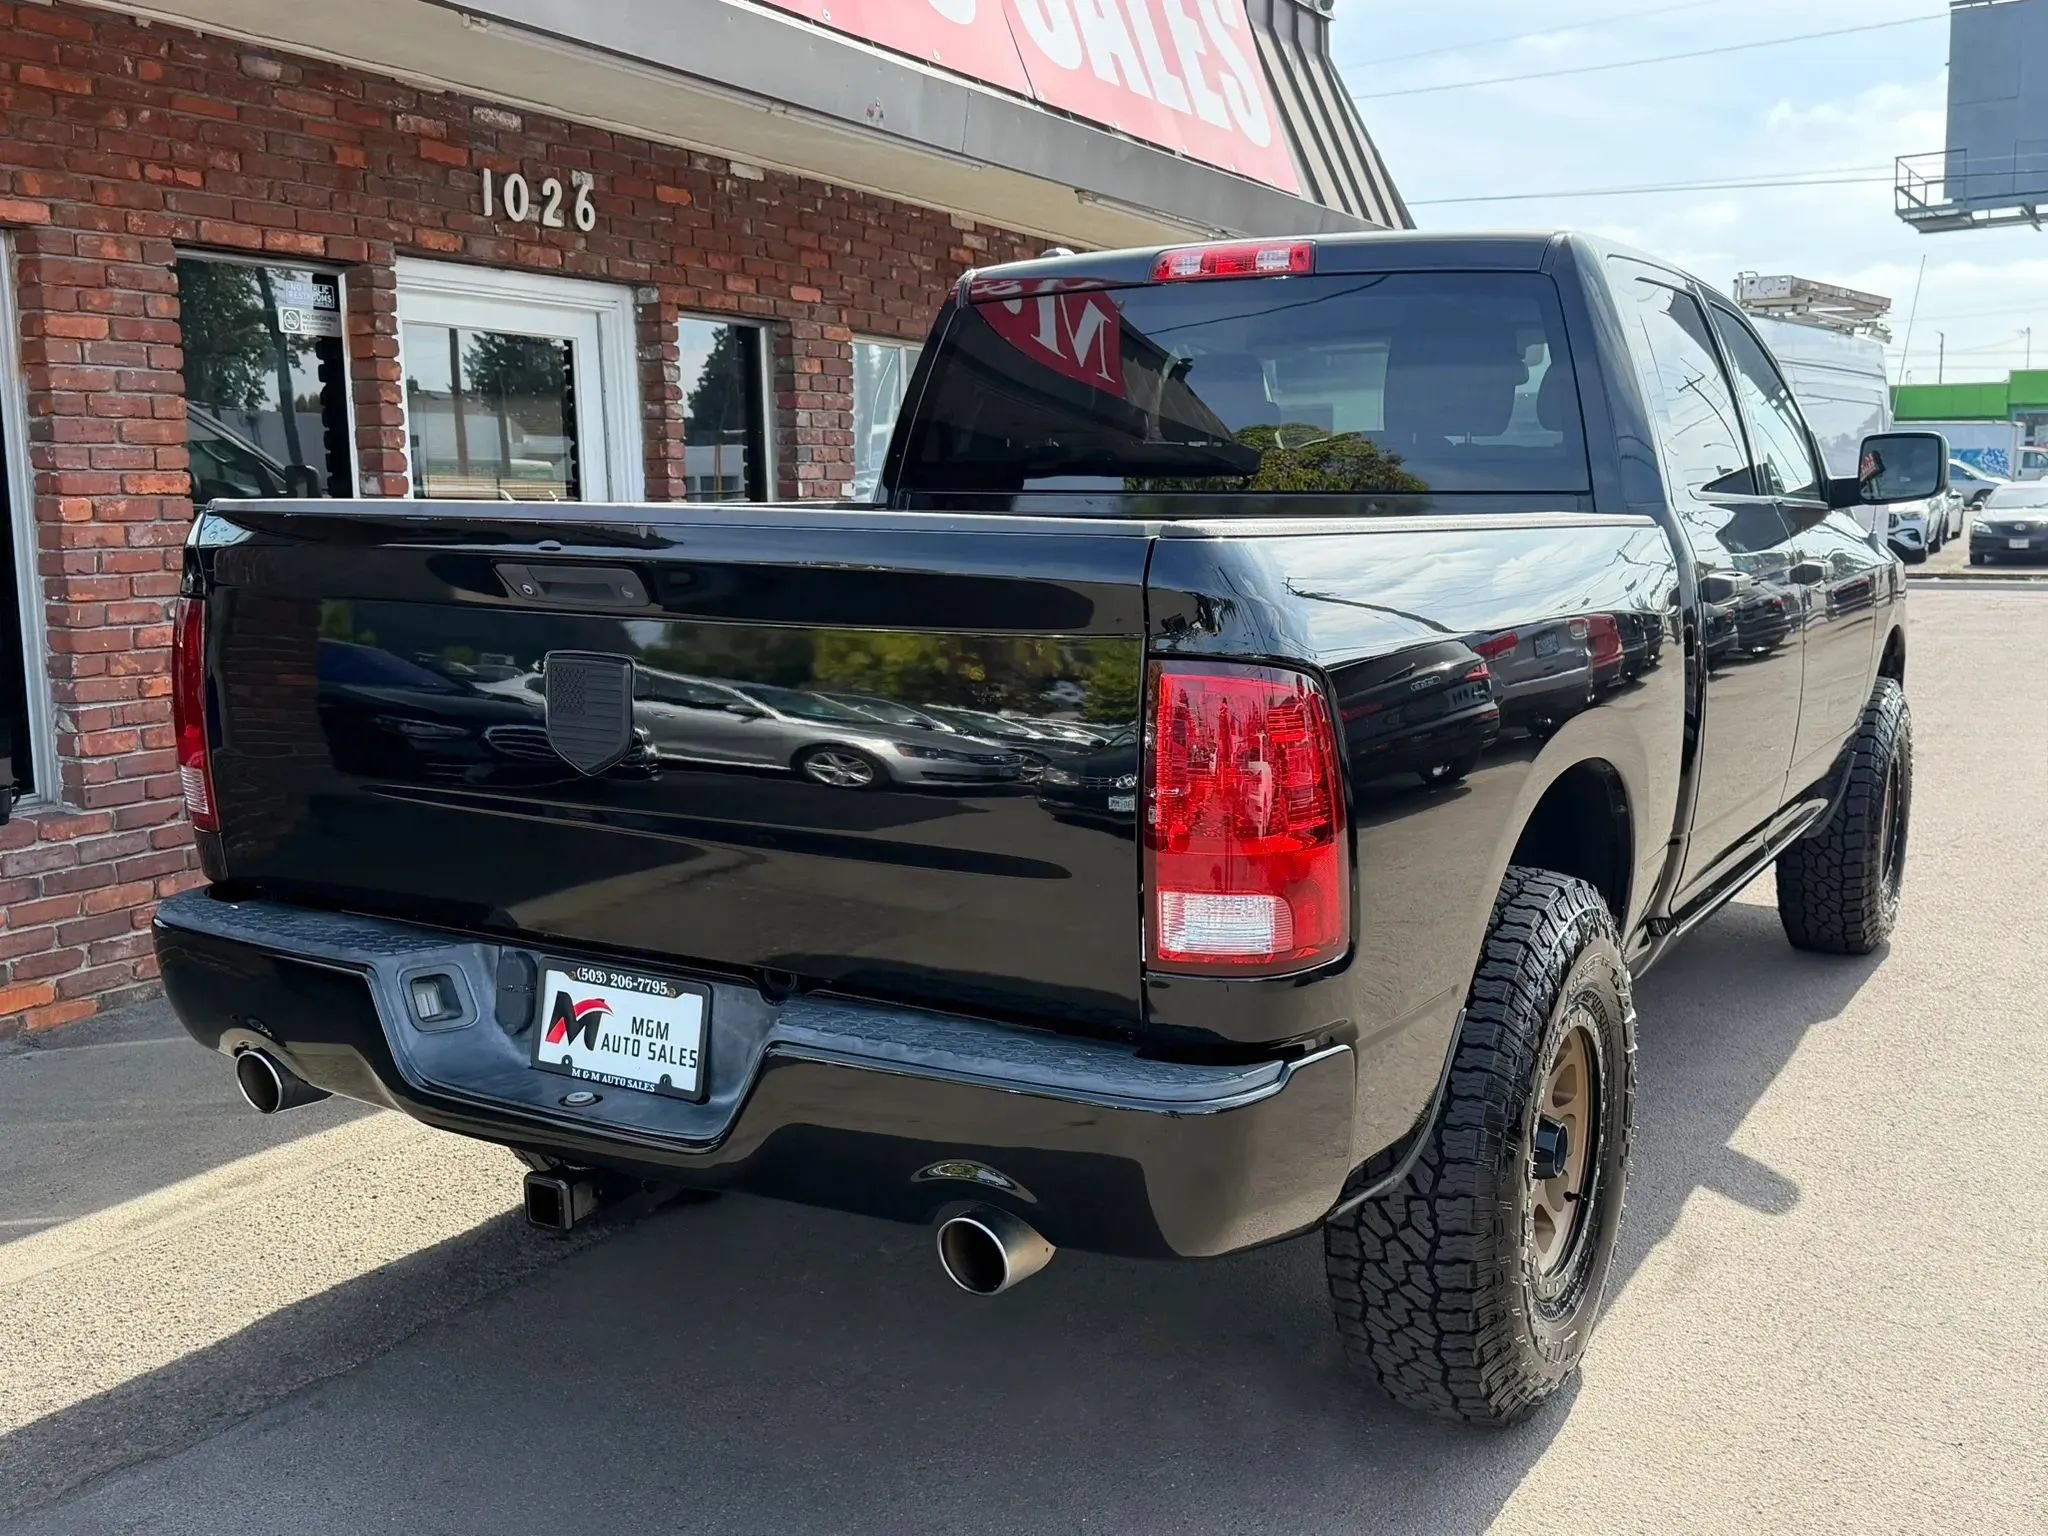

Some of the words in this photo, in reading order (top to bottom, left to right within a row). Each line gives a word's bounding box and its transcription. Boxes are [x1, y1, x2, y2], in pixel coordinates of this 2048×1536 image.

[483, 168, 596, 232] 1026
[576, 967, 607, 985] (503)
[610, 972, 668, 996] 206-7795
[631, 1016, 670, 1041] M&M
[600, 1032, 641, 1058] AUTO
[647, 1042, 697, 1069] SALES
[571, 1068, 581, 1078] M
[591, 1071, 600, 1082] M
[601, 1073, 626, 1086] AUTO
[627, 1078, 656, 1093] SALES
